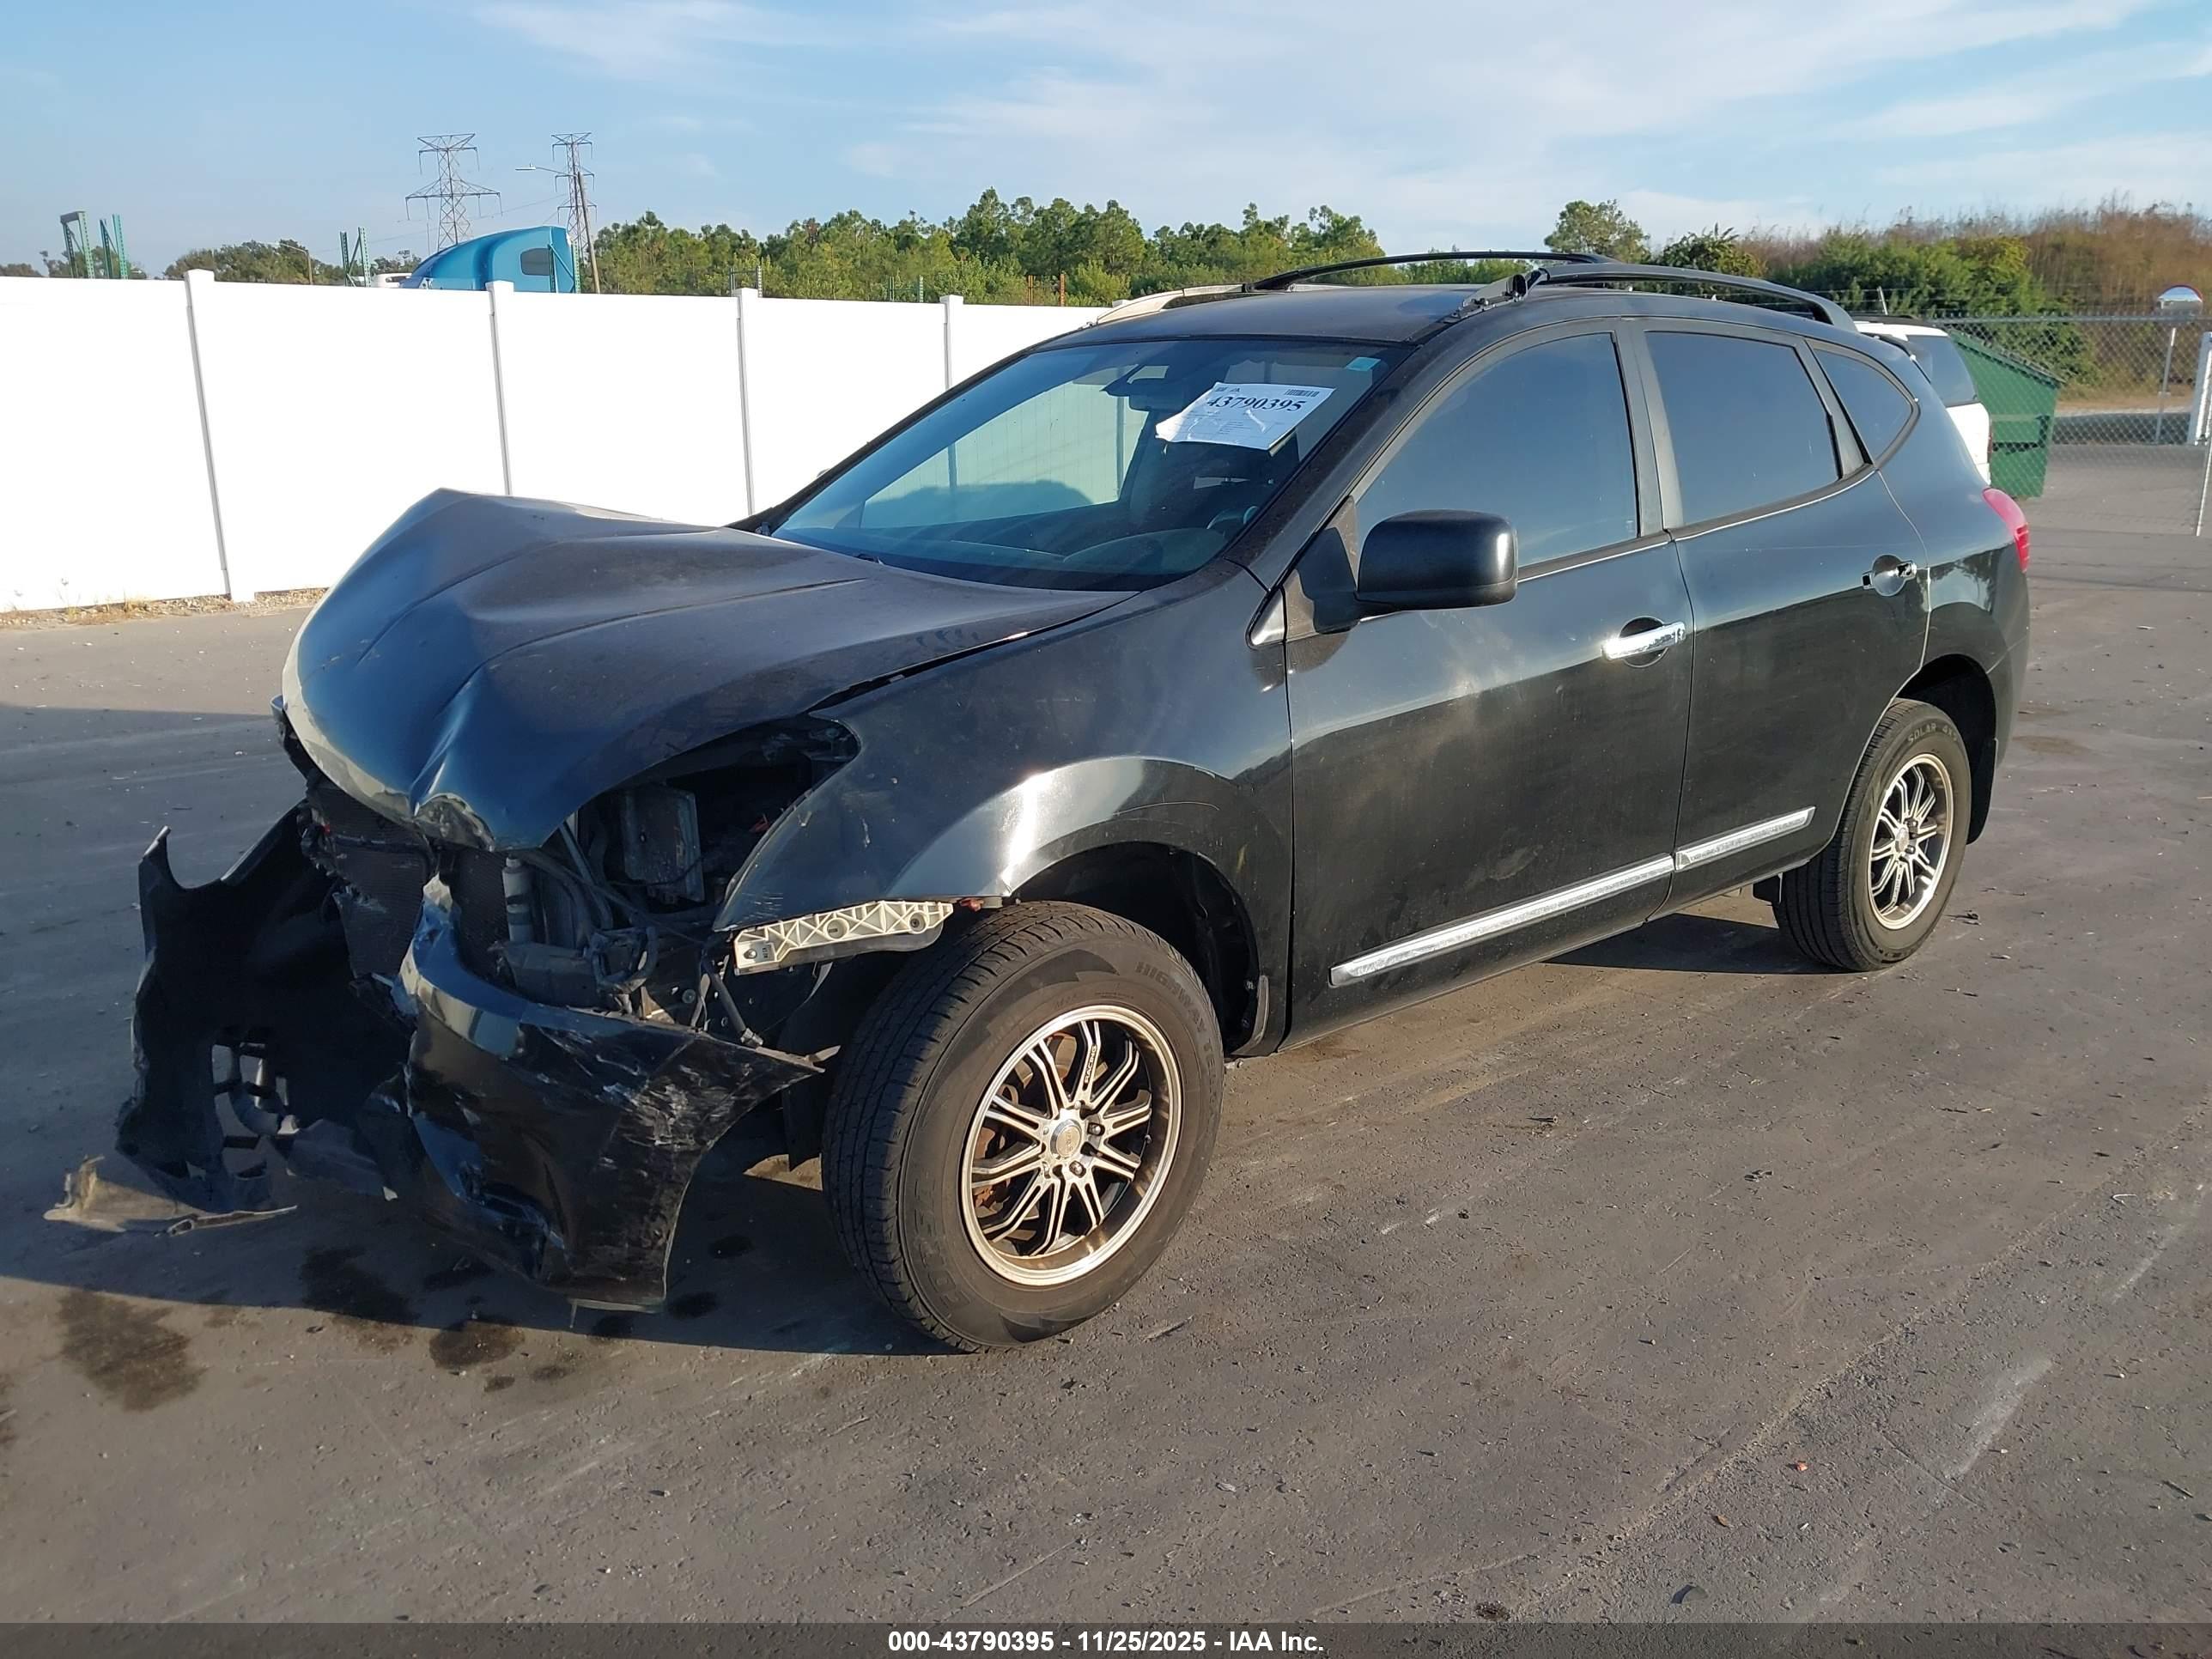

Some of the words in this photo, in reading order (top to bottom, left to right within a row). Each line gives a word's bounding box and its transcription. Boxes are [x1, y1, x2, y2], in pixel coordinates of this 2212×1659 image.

[1206, 395, 1307, 411] 43790395
[1907, 722, 1937, 744] SOLAR
[1085, 1044, 1097, 1084] RACING
